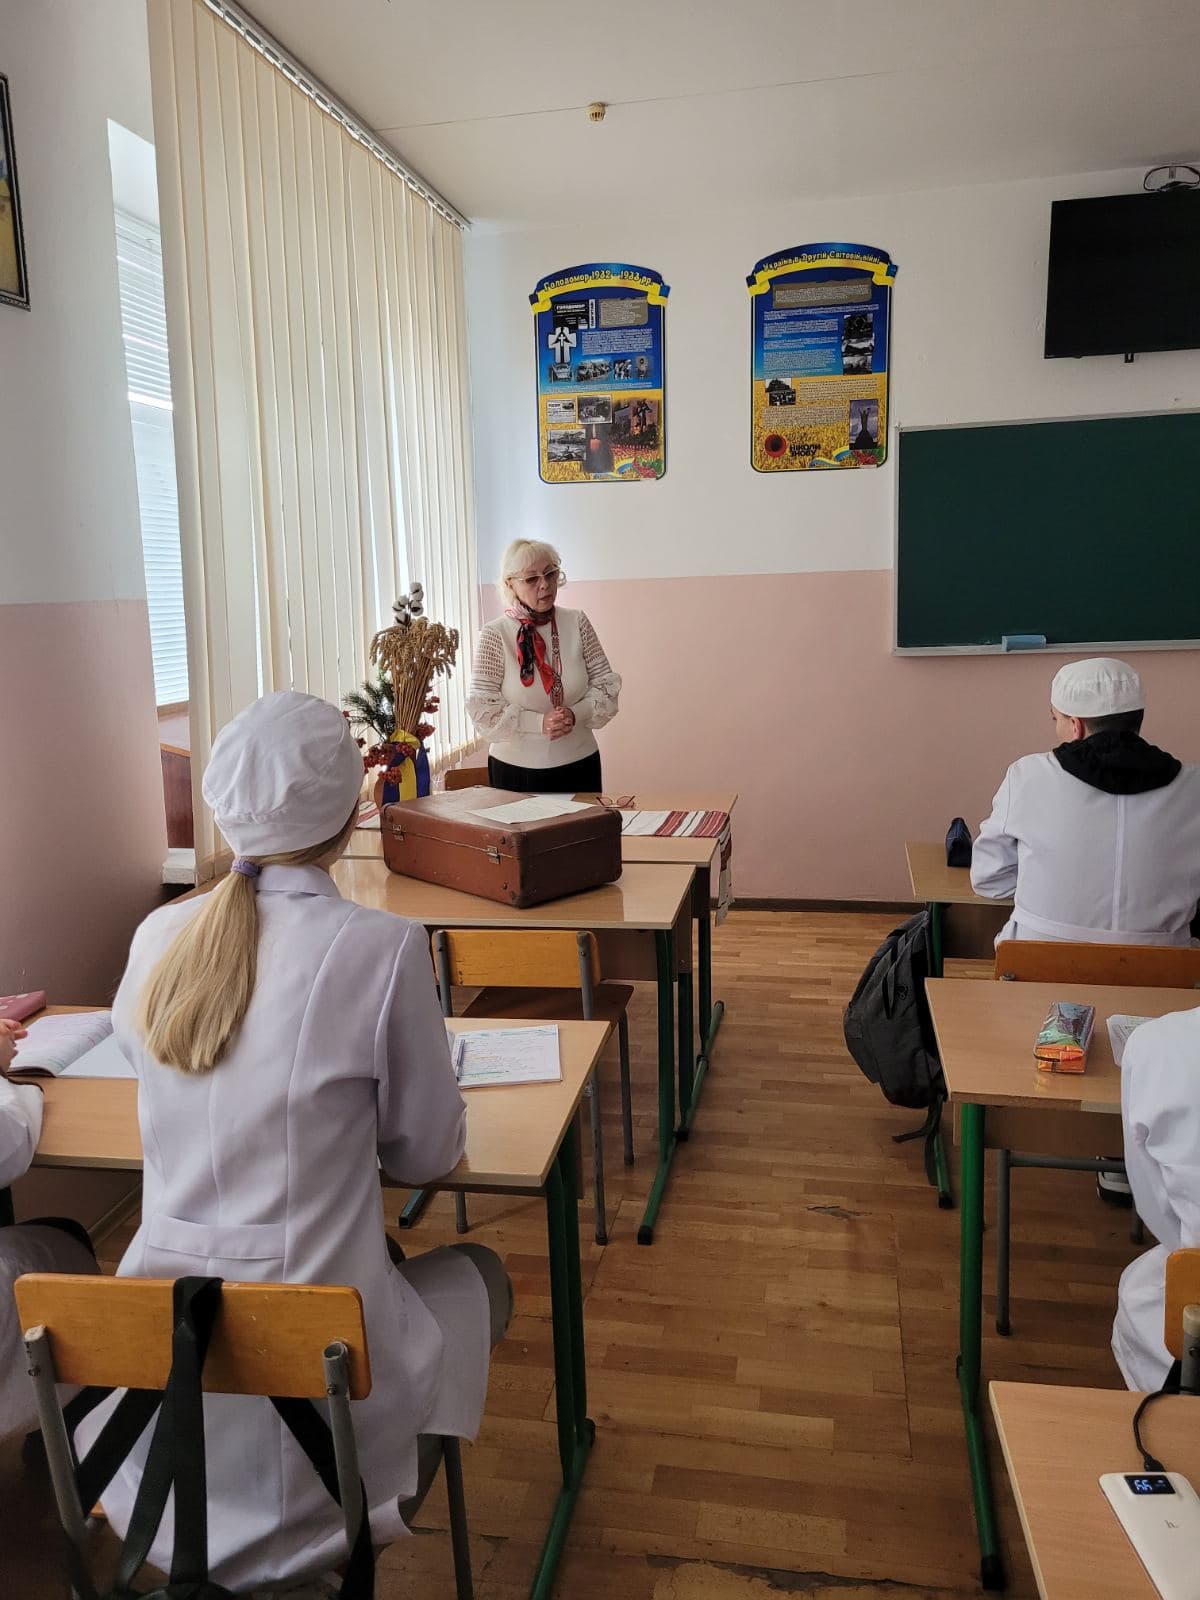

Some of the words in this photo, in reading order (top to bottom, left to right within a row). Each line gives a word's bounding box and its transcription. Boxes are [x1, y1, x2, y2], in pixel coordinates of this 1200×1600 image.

[763, 258, 793, 271] Україна
[801, 253, 827, 263] Другій
[829, 250, 861, 260] Світовій
[862, 253, 880, 265] війні
[543, 274, 589, 291] Голодомор
[591, 270, 612, 280] 1932
[620, 270, 640, 281] 1933
[789, 443, 821, 451] НІКОЛИ
[791, 449, 817, 457] ЗНОВУ
